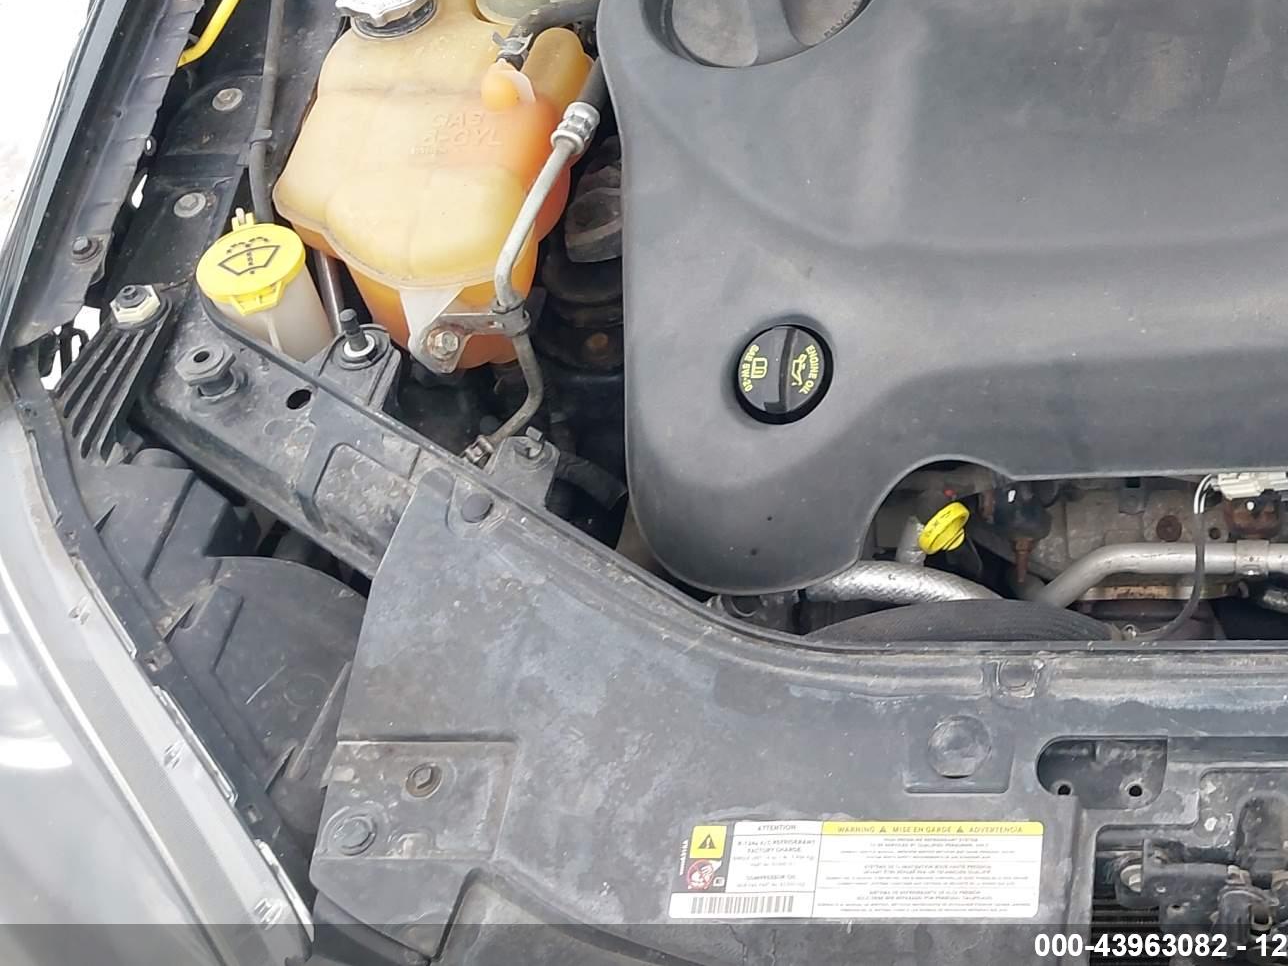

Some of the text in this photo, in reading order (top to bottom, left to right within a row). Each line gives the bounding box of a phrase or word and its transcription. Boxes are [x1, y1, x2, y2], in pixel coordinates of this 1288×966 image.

[741, 344, 760, 393] SAE 5W-20
[798, 344, 820, 395] ENGINE OIL
[757, 824, 797, 832] ATTENTION
[837, 825, 875, 833] WARNING
